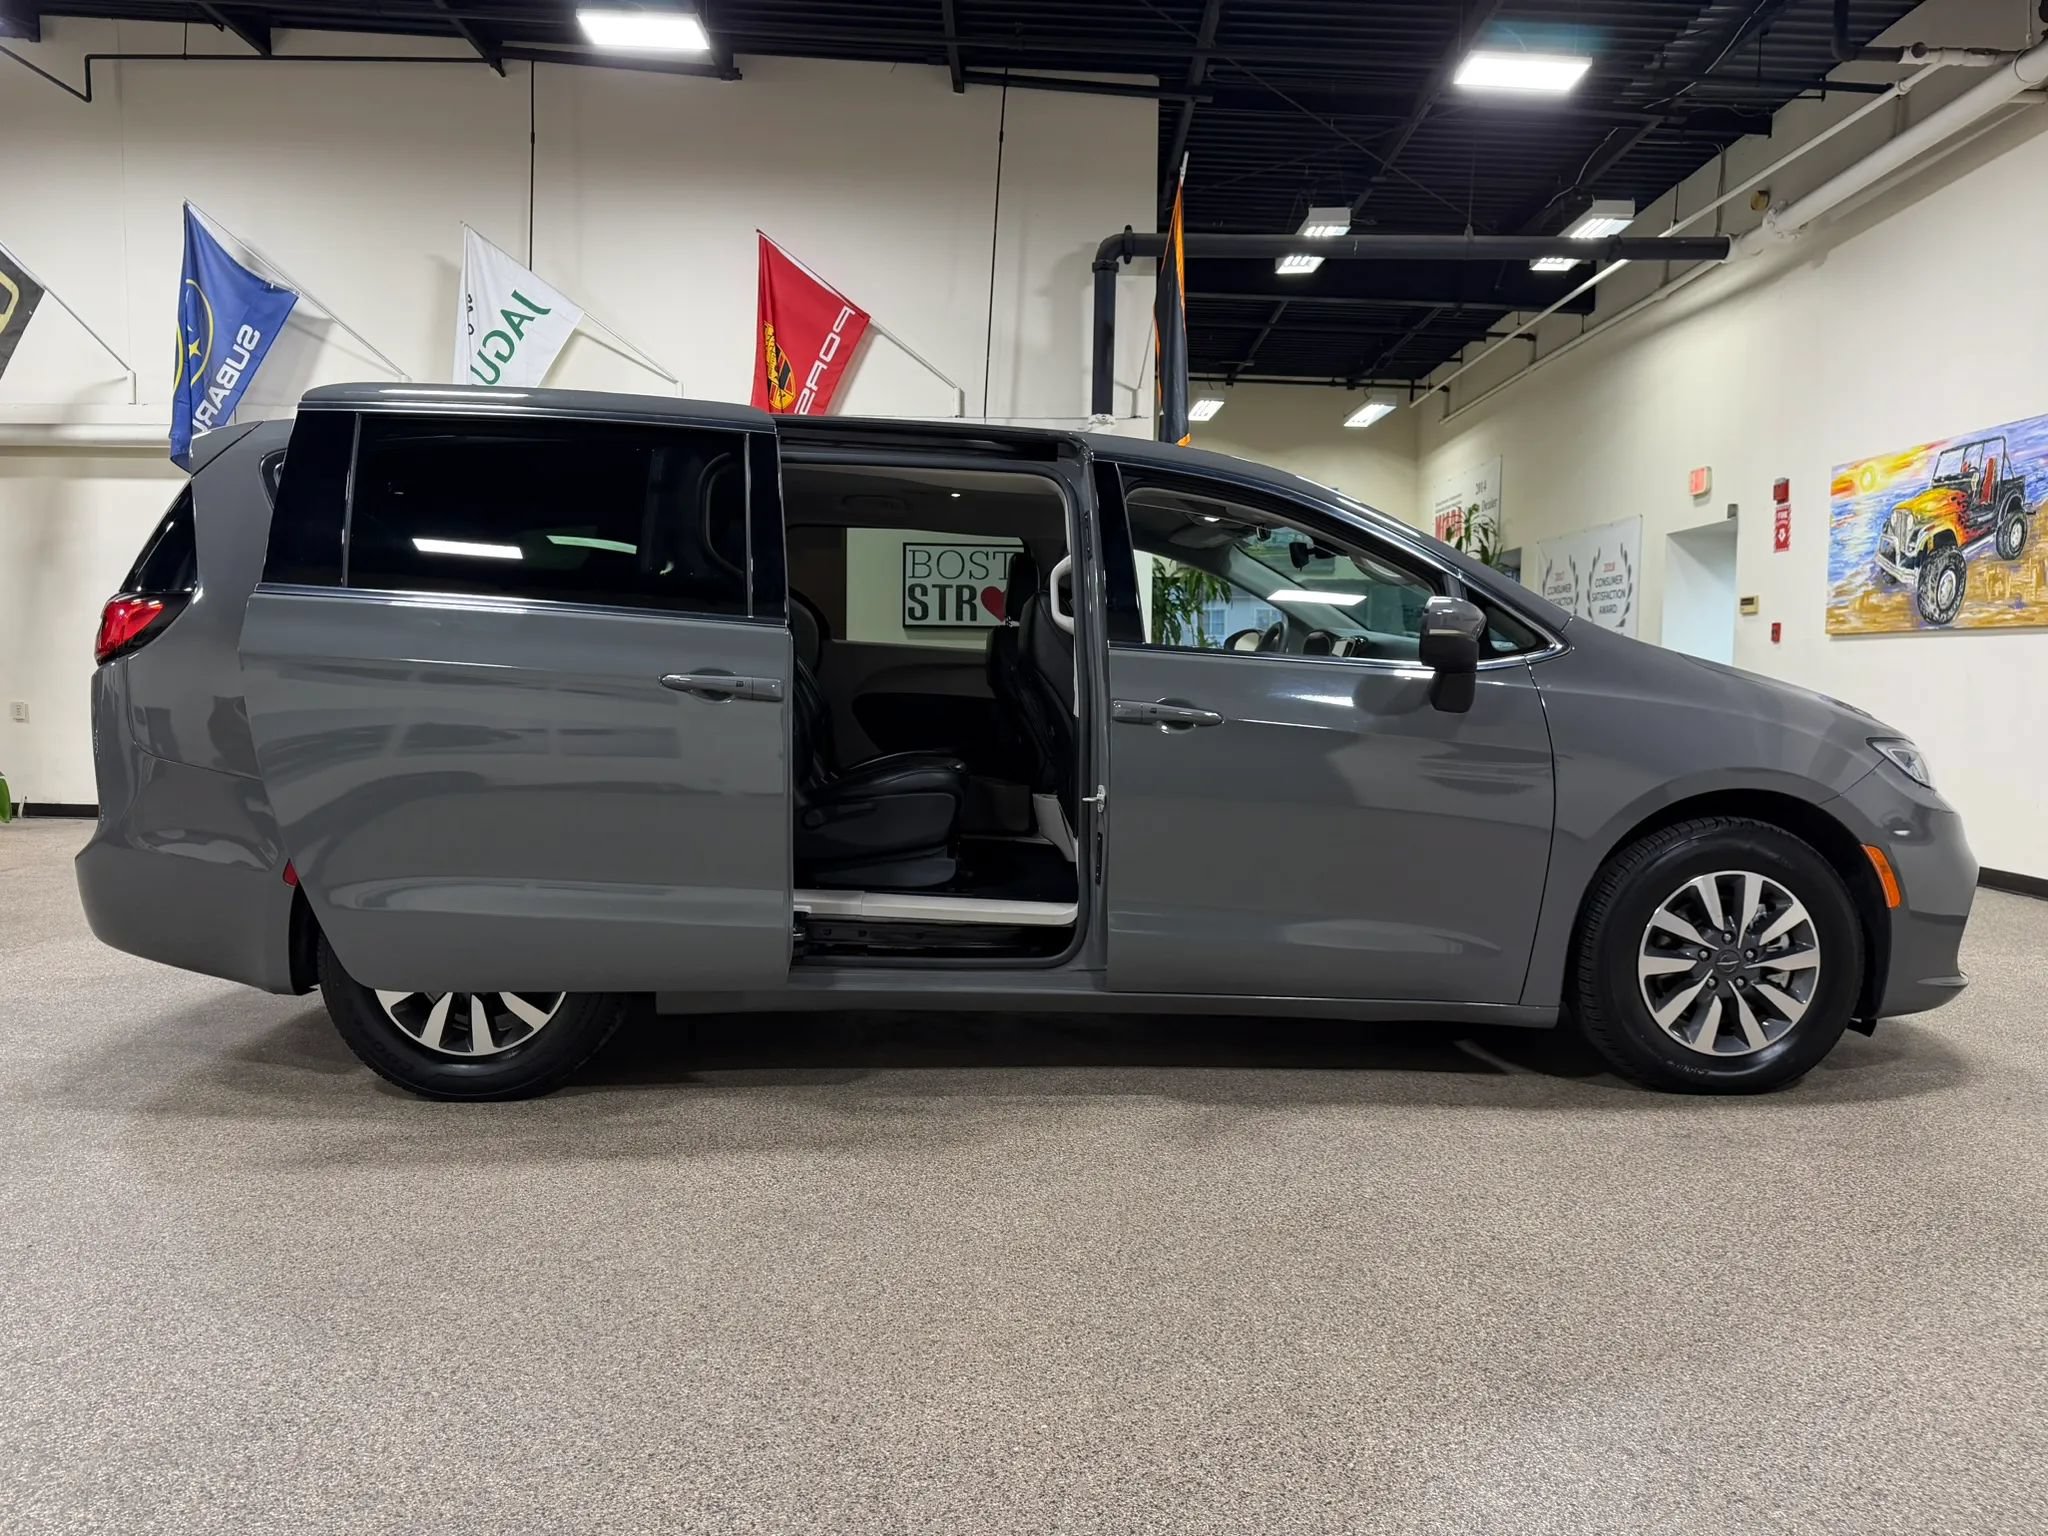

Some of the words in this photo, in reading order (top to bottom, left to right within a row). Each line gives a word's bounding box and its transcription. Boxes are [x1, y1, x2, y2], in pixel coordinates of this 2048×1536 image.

[908, 549, 1015, 581] BOST
[1595, 574, 1623, 588] CONSUMER
[1547, 583, 1572, 595] CONSUMER
[1591, 588, 1626, 602] SATISFACTION
[1599, 604, 1618, 614] AWARD
